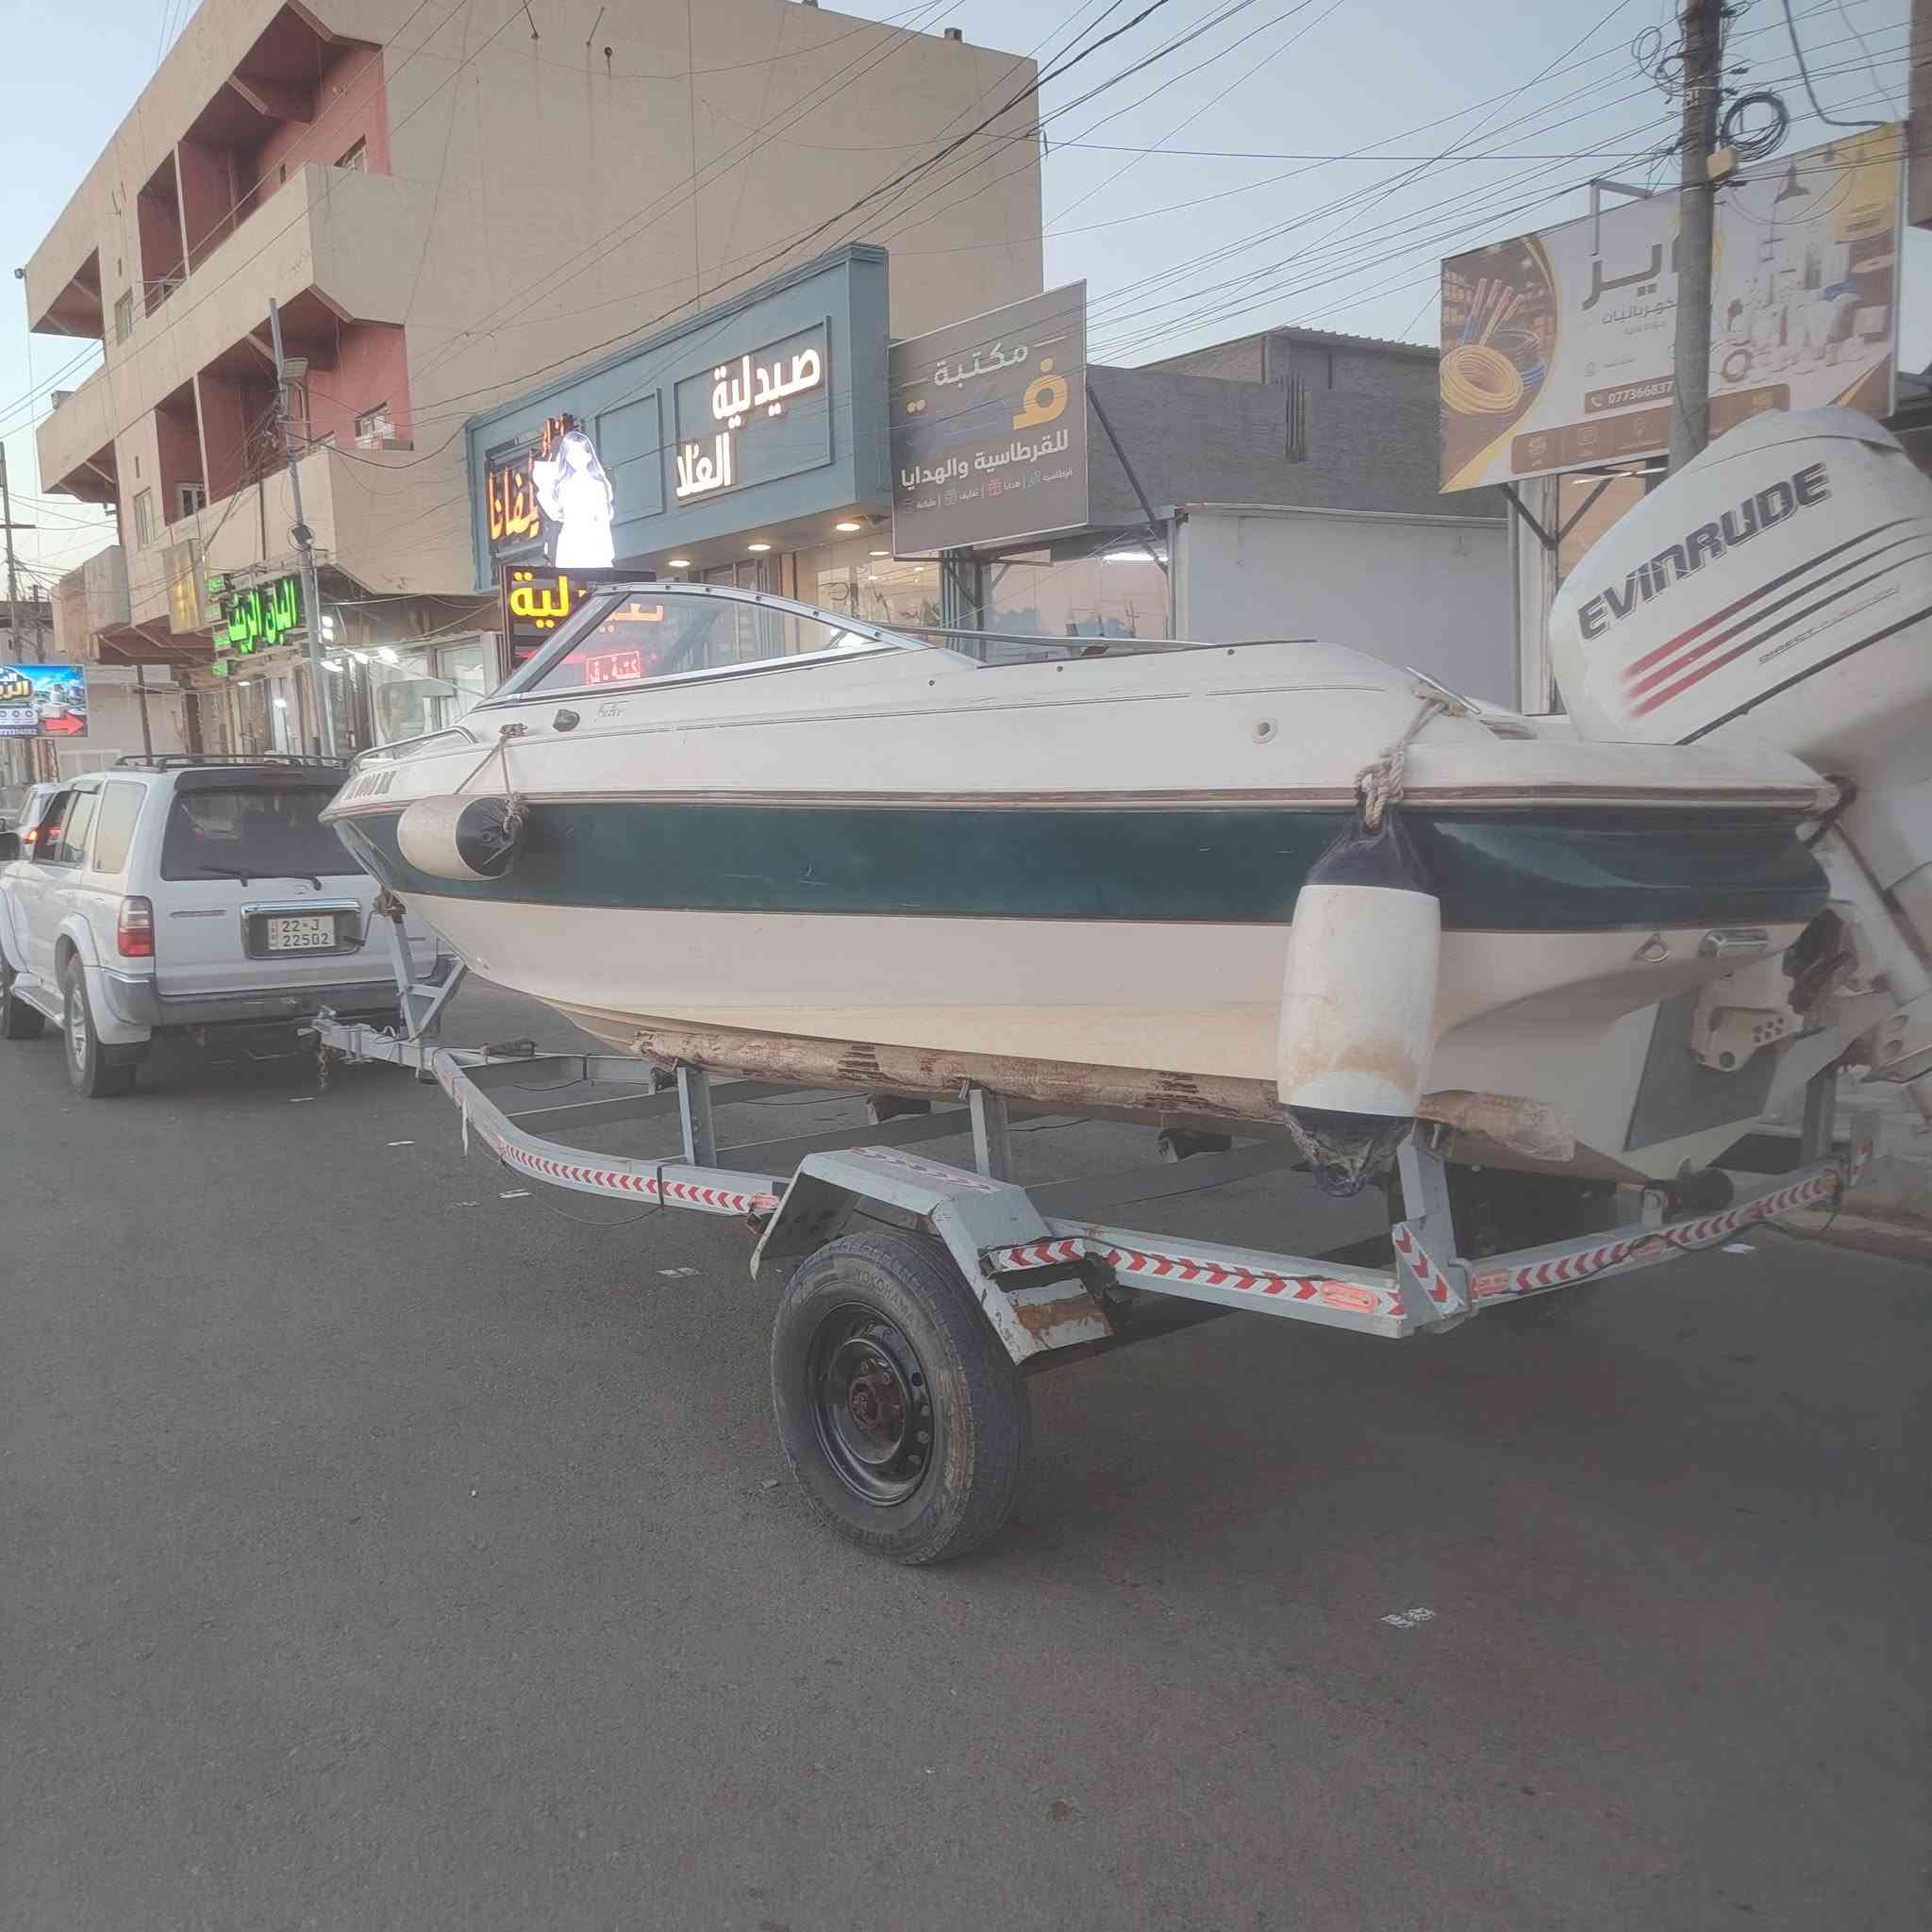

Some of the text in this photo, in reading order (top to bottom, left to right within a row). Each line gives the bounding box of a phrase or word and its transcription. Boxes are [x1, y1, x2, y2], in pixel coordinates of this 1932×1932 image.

[712, 348, 821, 429] صيدلية
[933, 342, 1028, 389] مكتبة
[900, 428, 1069, 491] للقرطاسية والهدايا
[1577, 460, 1833, 641] EVINRUDE
[282, 932, 330, 947] 22502
